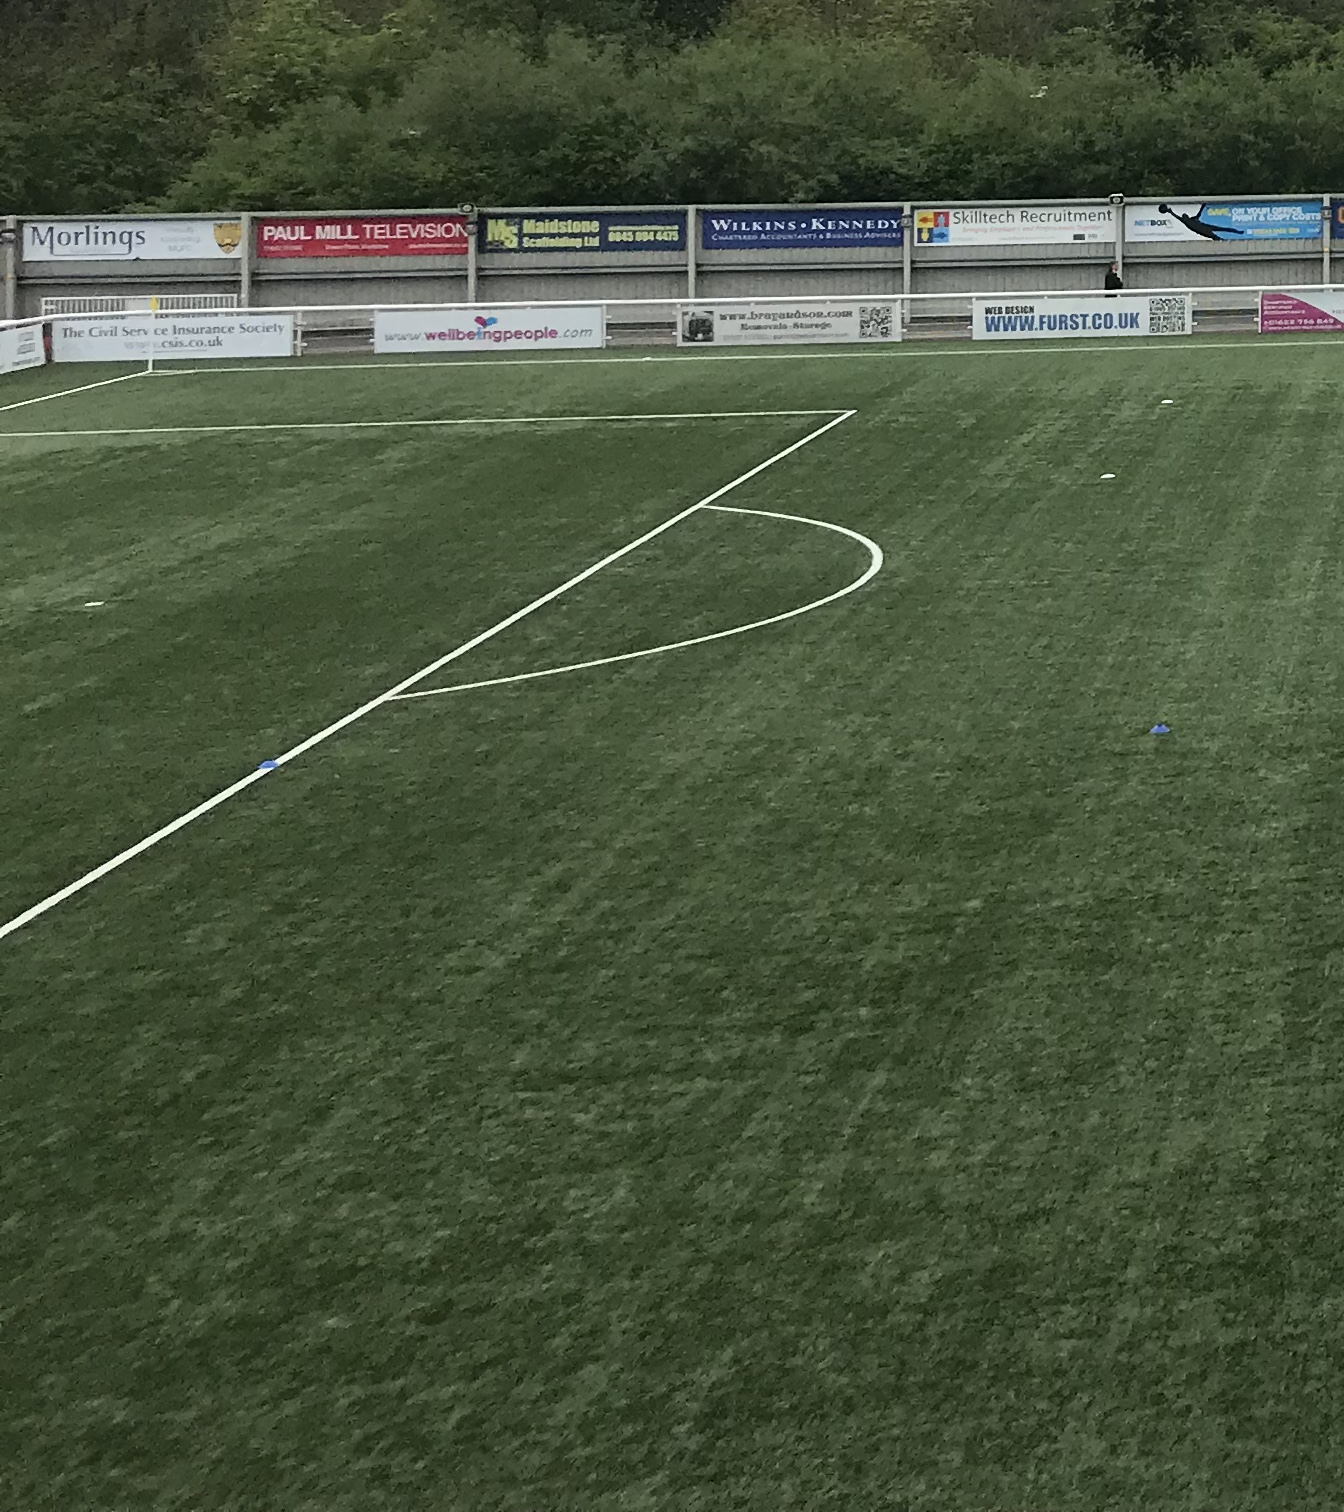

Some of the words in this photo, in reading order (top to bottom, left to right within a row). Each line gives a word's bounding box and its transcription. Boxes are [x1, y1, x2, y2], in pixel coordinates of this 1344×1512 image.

[711, 219, 797, 232] WILKINS
[812, 217, 902, 231] KENNEDY
[952, 209, 1015, 225] Skilltech
[1020, 208, 1113, 223] Recruitment
[263, 226, 313, 241] PAUL
[316, 225, 360, 240] MILL
[363, 222, 469, 239] TELEVISION
[522, 219, 600, 234] Maidstone
[31, 225, 147, 256] Morlings
[985, 306, 1004, 315] WEB
[1005, 305, 1035, 315] DESIGN
[62, 327, 84, 339] The
[88, 325, 118, 338] Civil
[121, 324, 170, 337] Servce
[173, 322, 234, 336] Insurance
[239, 320, 286, 336] Society
[985, 312, 1140, 333] WWW.FURST.CO.UK
[384, 326, 593, 344] www.wellbeingpeople.com
